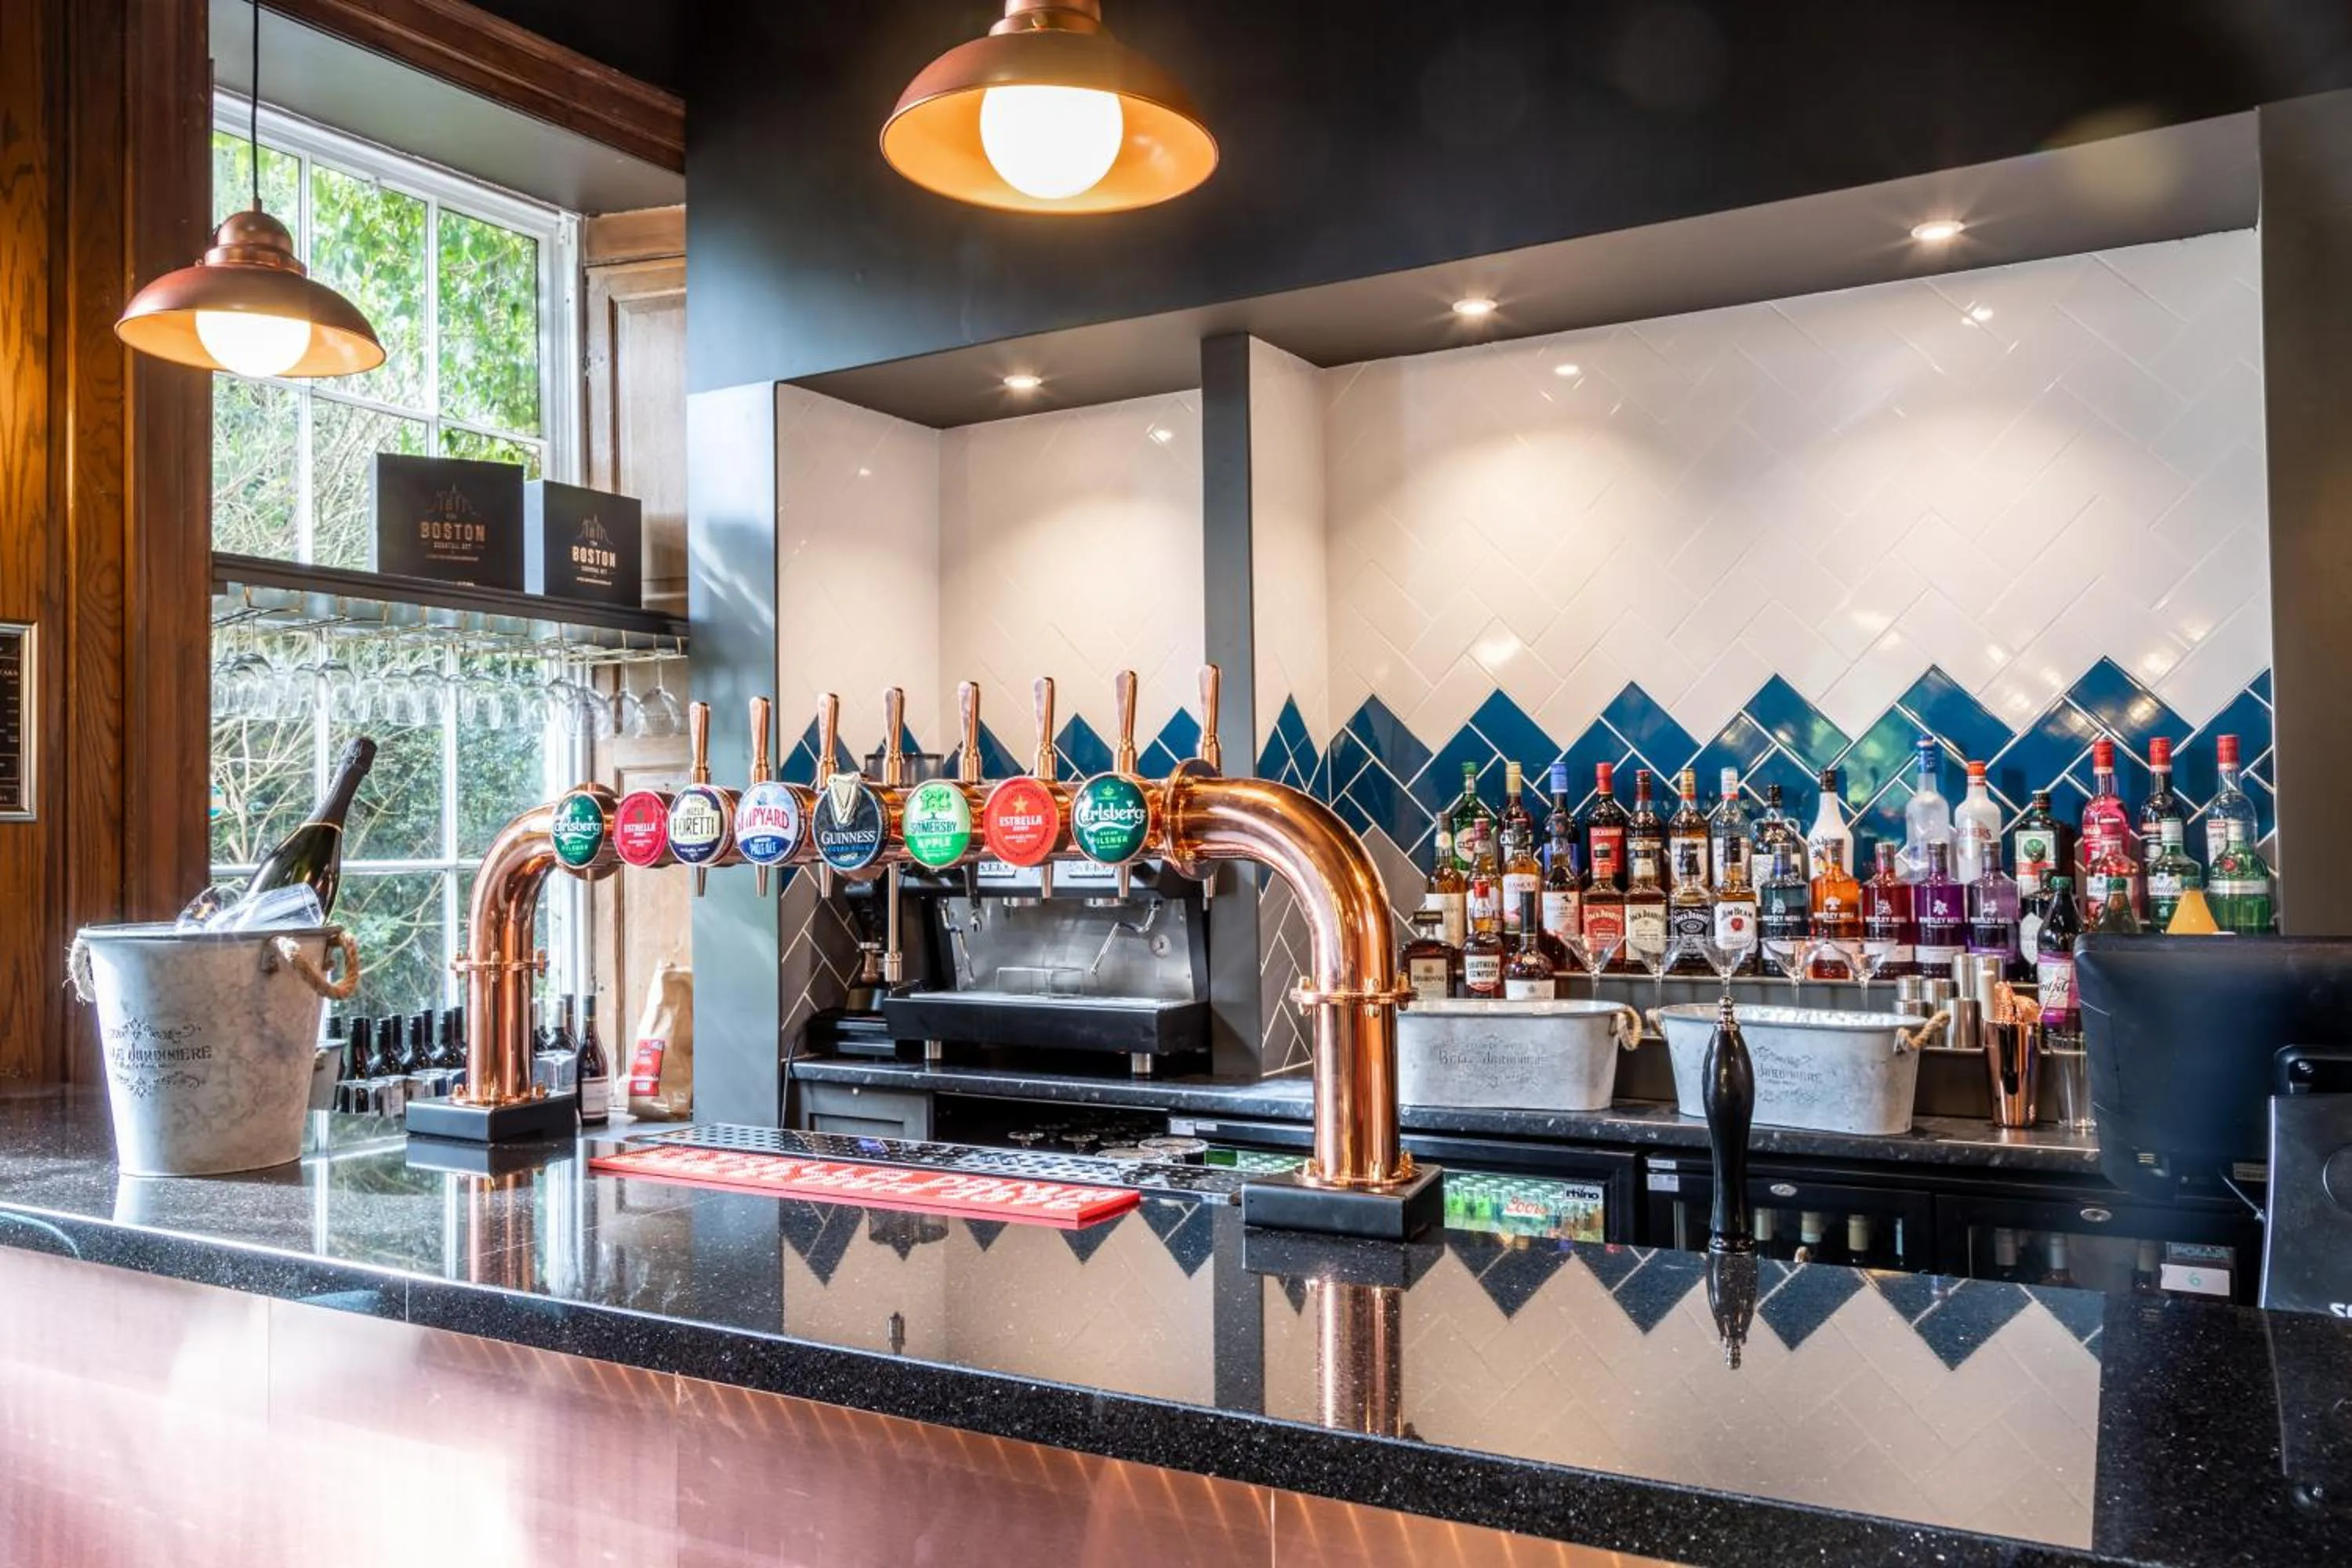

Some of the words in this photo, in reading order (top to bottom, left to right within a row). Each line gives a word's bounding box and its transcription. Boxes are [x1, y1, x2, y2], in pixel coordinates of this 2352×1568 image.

[421, 521, 485, 542] BOSTON
[572, 545, 615, 568] BOSTON
[1075, 797, 1146, 828] Carlsberg
[821, 830, 876, 844] GUINNESS
